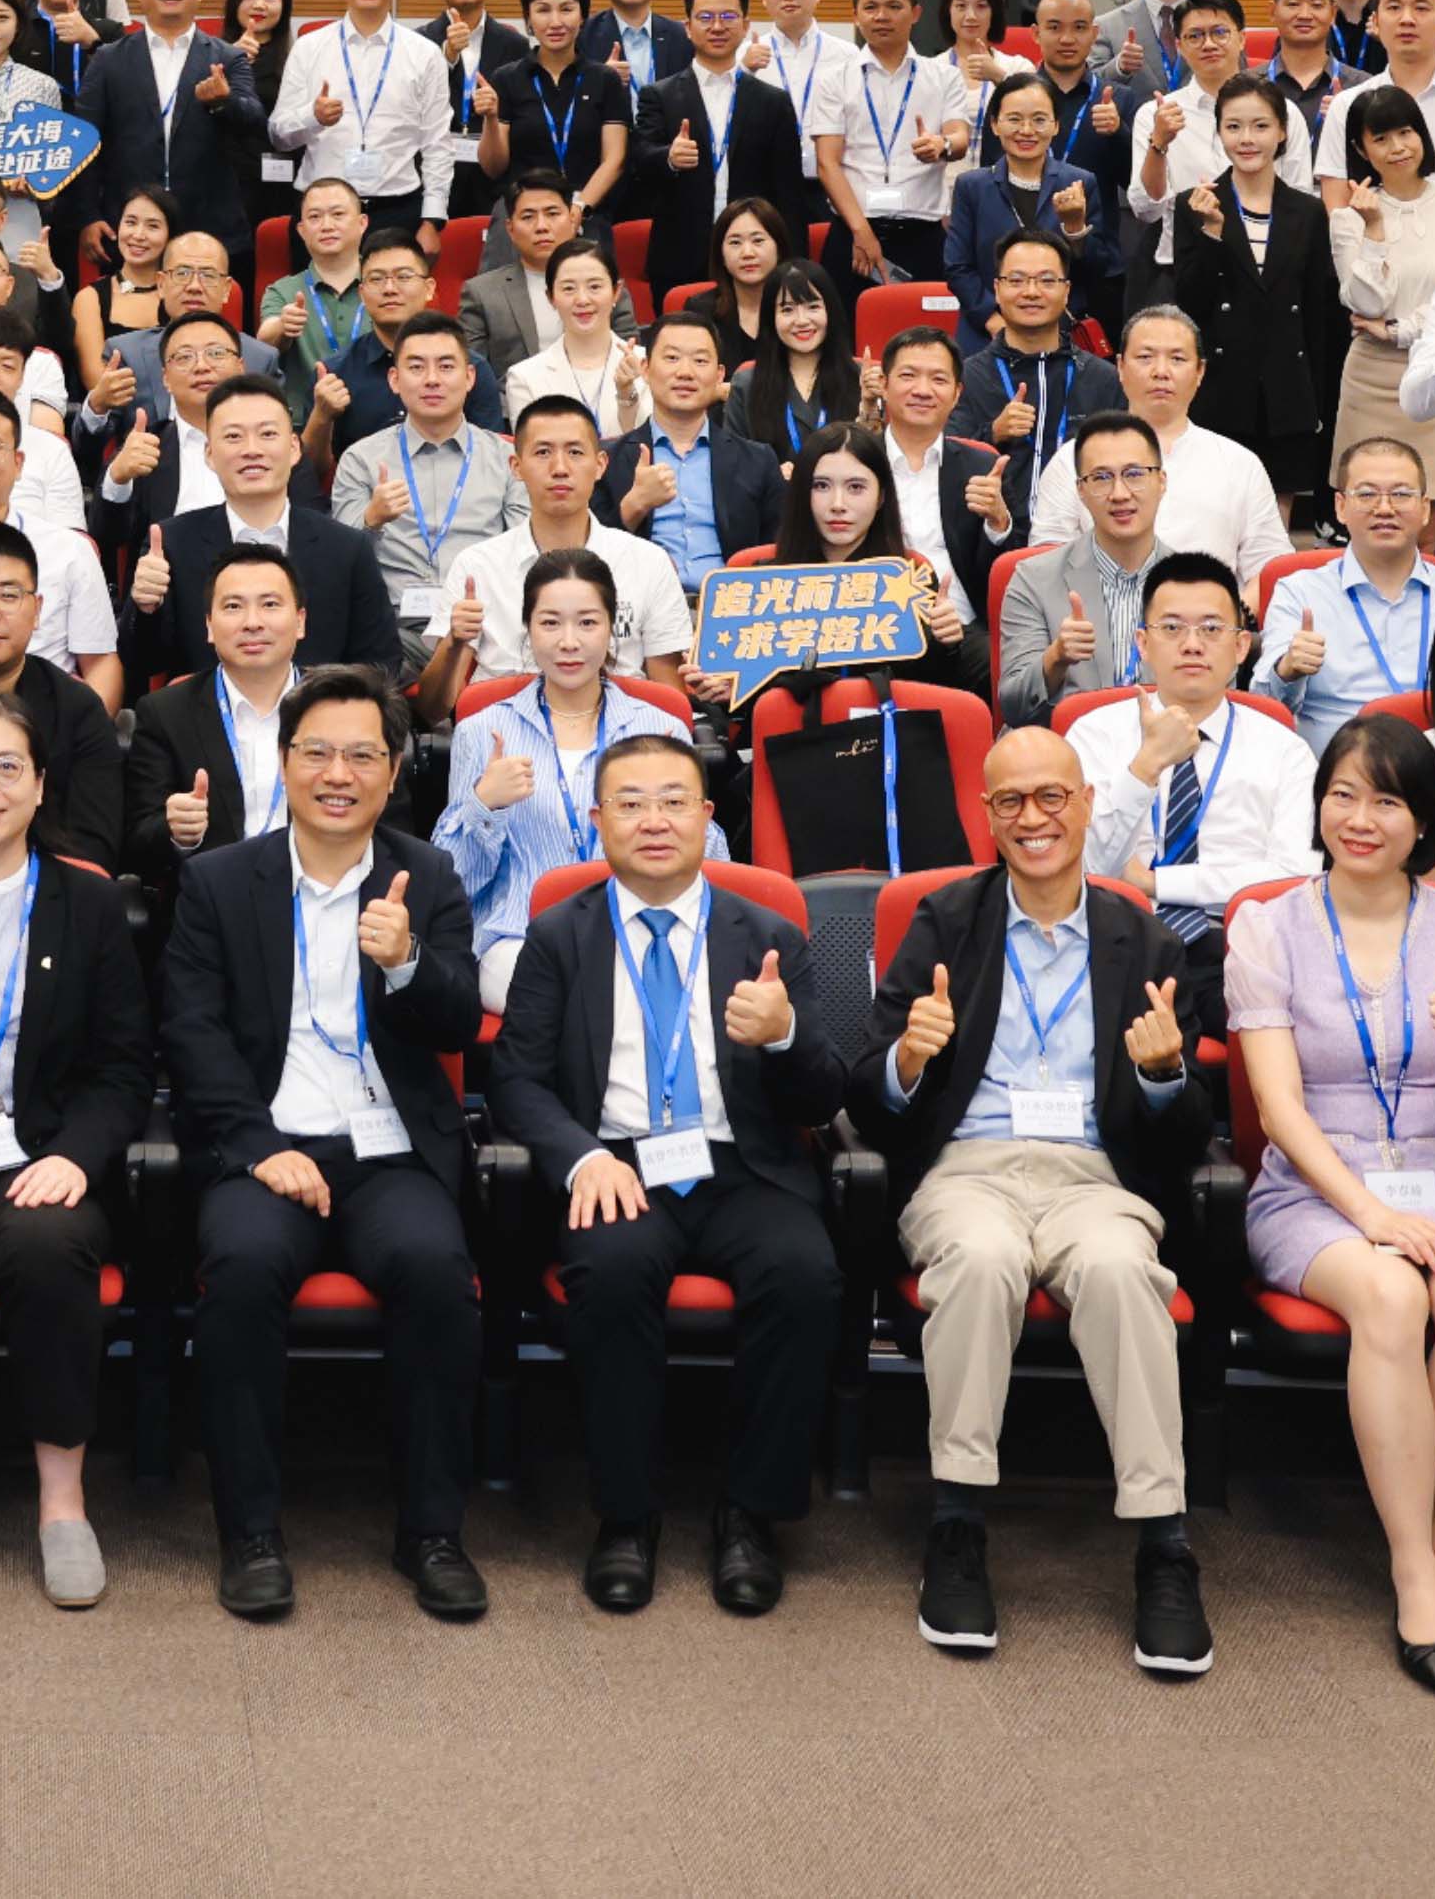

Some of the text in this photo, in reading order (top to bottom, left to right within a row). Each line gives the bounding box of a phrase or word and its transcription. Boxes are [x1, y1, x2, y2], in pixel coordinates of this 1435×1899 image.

[712, 572, 878, 619] 追光而遇
[734, 614, 900, 660] 求学路长
